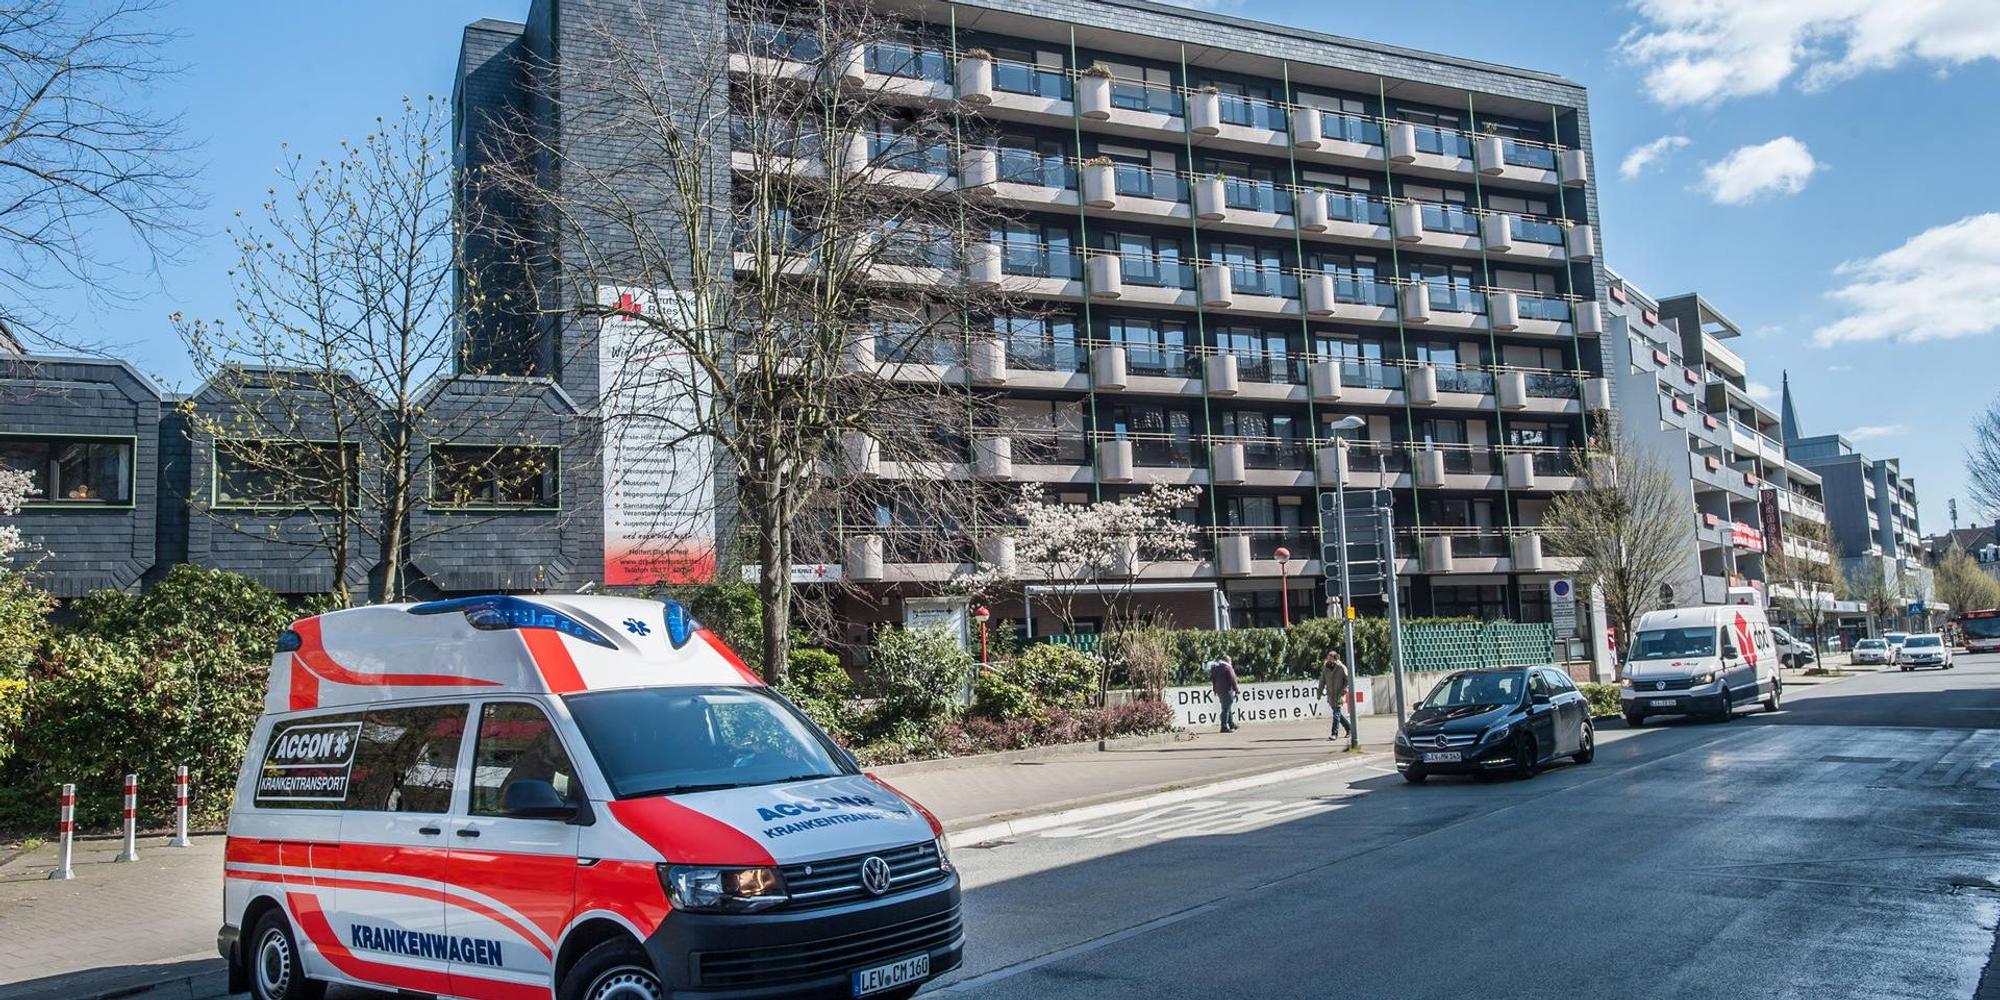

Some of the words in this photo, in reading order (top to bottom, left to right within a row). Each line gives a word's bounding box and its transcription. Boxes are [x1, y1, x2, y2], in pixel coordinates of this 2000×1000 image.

[1178, 690, 1213, 705] DRK
[1225, 685, 1328, 703] reisverban
[1188, 706, 1288, 724] Levkusen
[275, 733, 335, 759] ACCON
[261, 776, 346, 791] KRANKENTRANSPORT
[757, 795, 859, 822] ACCON
[763, 810, 907, 839] KRANKENTRANS
[351, 924, 503, 967] KRANKENWAGEN
